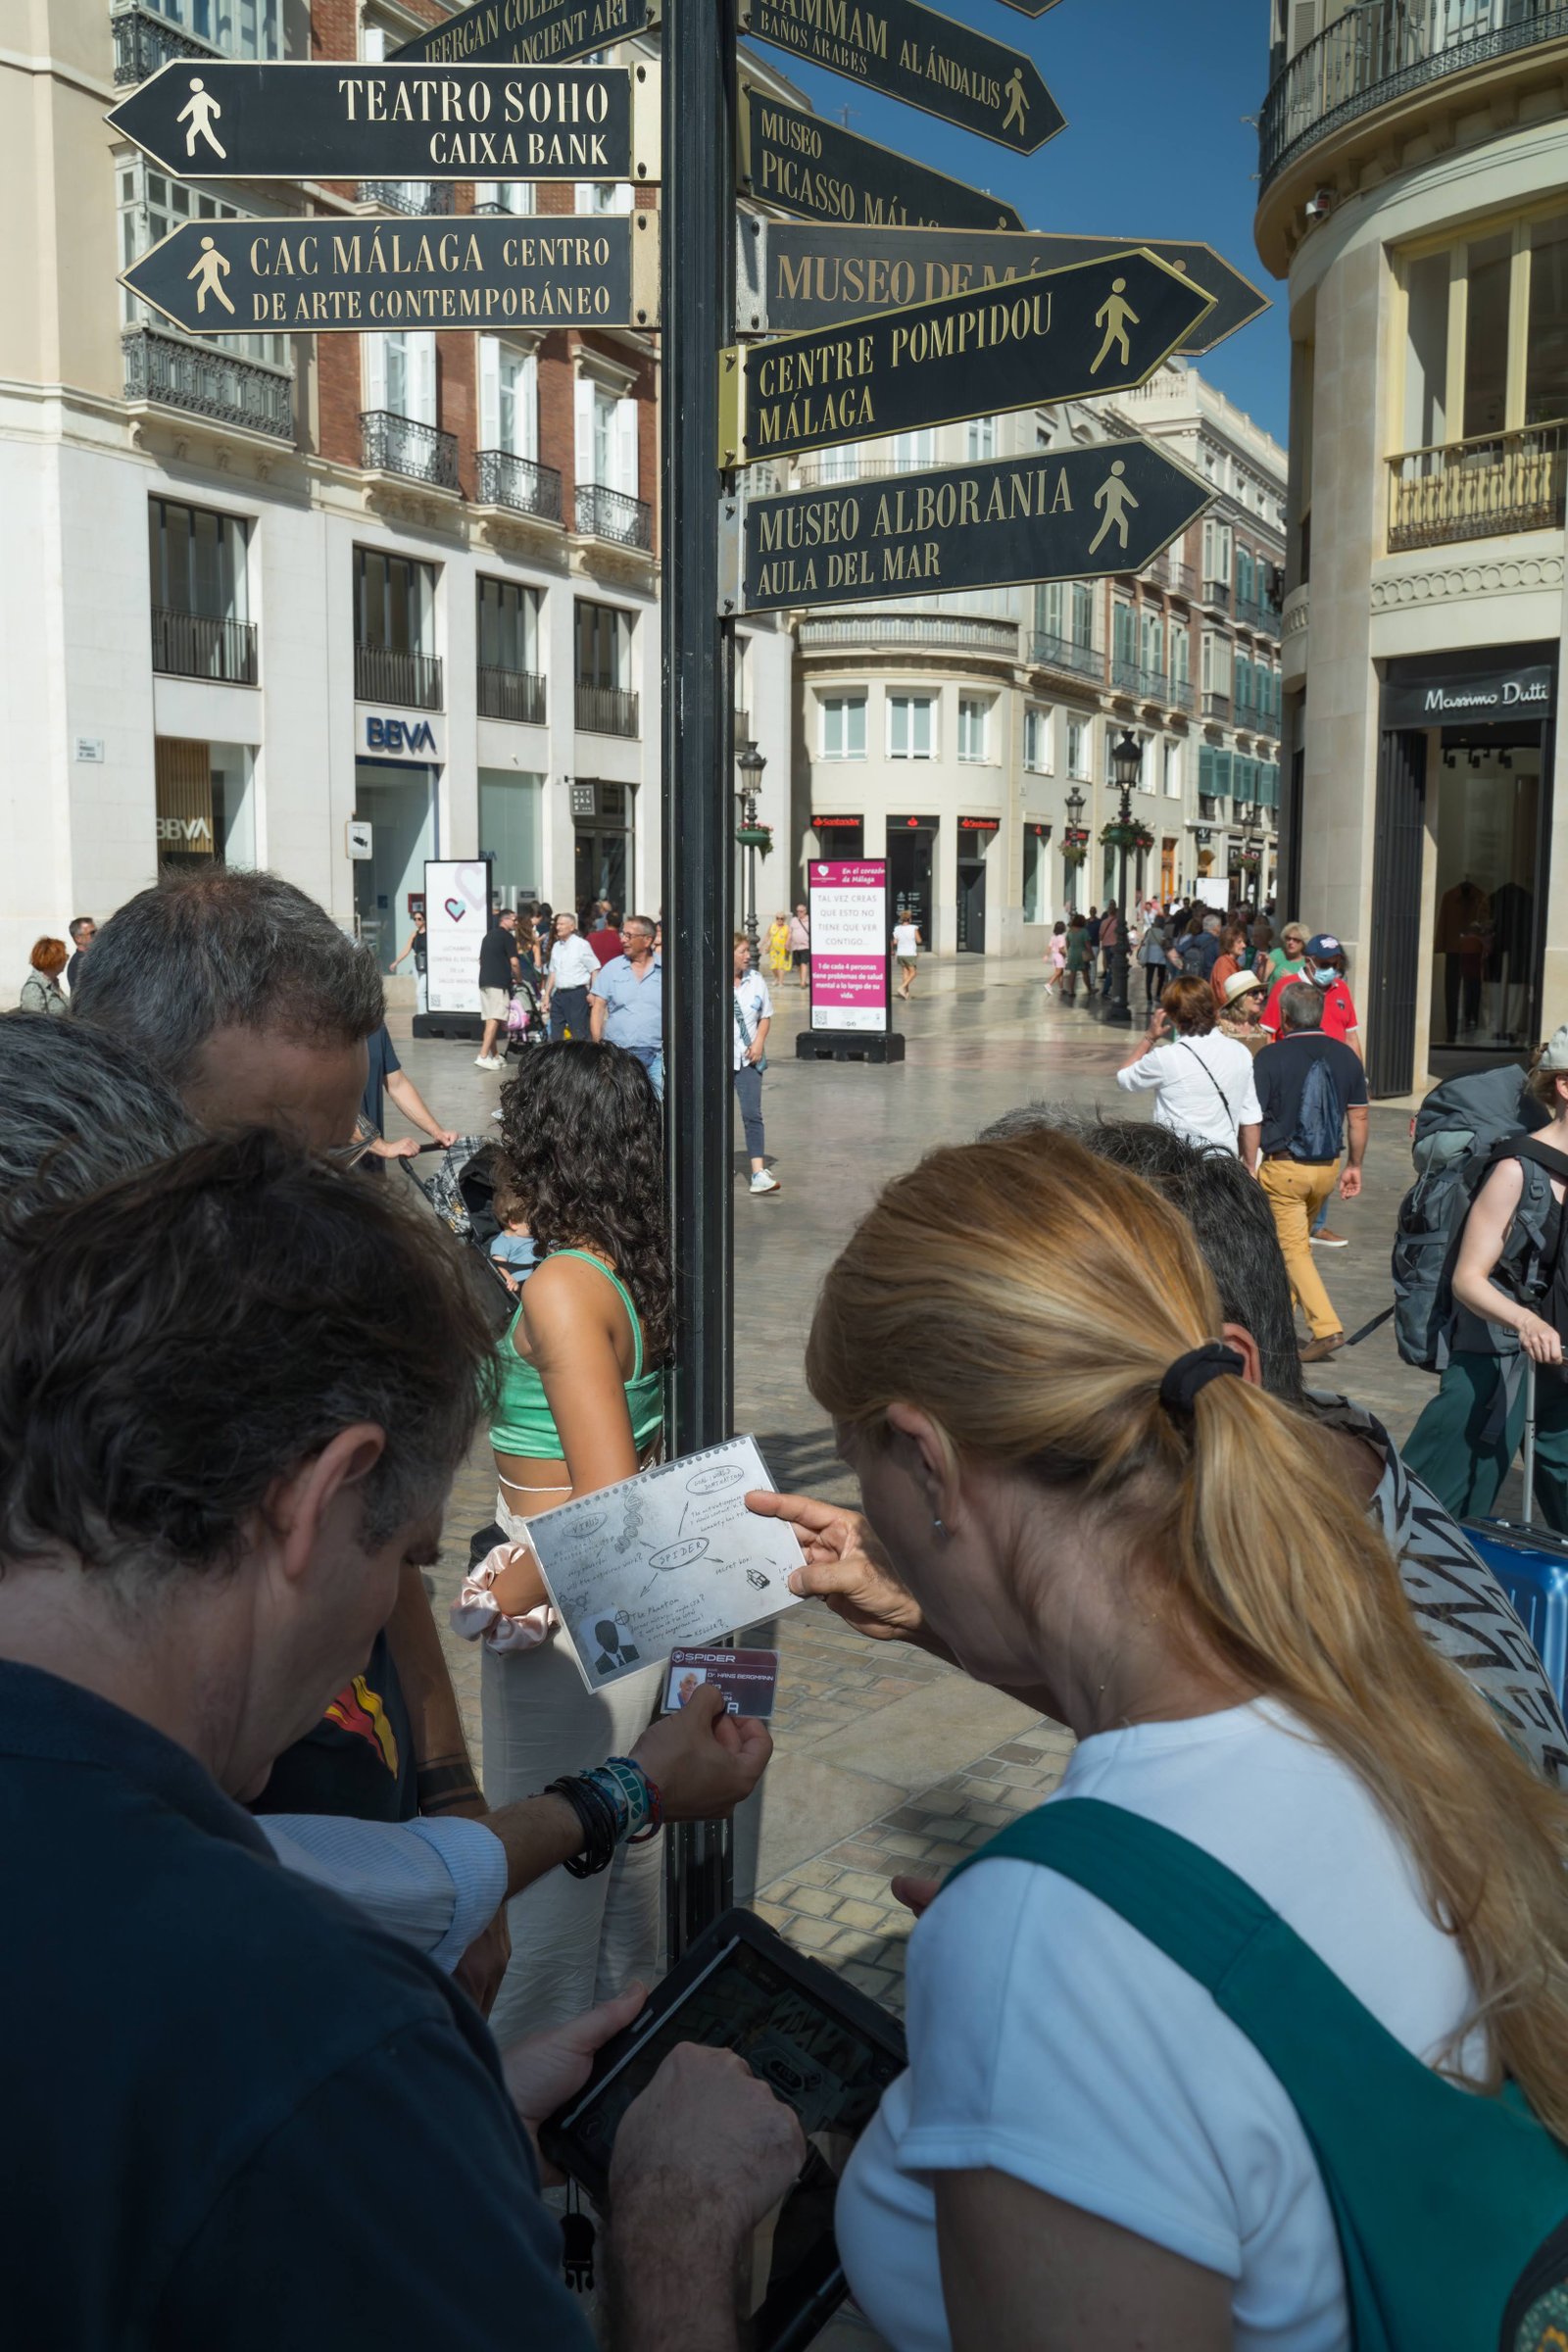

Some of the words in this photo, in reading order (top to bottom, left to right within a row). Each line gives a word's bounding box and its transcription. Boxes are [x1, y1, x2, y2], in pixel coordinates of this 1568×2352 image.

[512, 9, 587, 63] ANCIENT
[591, 0, 627, 36] ART
[760, 10, 808, 49] BAÑOS
[811, 30, 868, 75] ÁRABES
[899, 39, 922, 74] AL
[925, 44, 1001, 110] ÁNDALUS
[339, 79, 492, 122] TEATRO
[504, 81, 610, 123] SOHO
[428, 133, 520, 165] CAIXA
[528, 133, 610, 166] BANK
[761, 108, 822, 160] MUSEO
[760, 149, 856, 221] PICASSO
[249, 235, 319, 277] CAC
[332, 225, 485, 275] MÁLAGA
[502, 236, 611, 269] CENTRO
[252, 292, 286, 321] DE
[294, 289, 363, 321] ARTE
[368, 280, 611, 319] CONTEMPORÁNEO
[775, 254, 915, 305] MUSEO
[923, 262, 973, 301] DE
[759, 333, 876, 399] CENTRE
[889, 292, 1054, 368] POMPIDOU
[757, 385, 876, 446] MÁLAGA
[758, 497, 860, 554] MUSEO
[871, 466, 1075, 538] ALBORANIA
[757, 557, 818, 597] AULA
[827, 552, 875, 588] DEL
[882, 542, 942, 582] MAR
[1425, 689, 1497, 710] Massimo
[1501, 682, 1548, 705] Dutti
[366, 717, 437, 755] BBVA
[156, 816, 211, 841] BBVA
[823, 817, 860, 826] Santander
[659, 1541, 703, 1565] SPIDER
[685, 1653, 736, 1663] SPIDER
[726, 1702, 739, 1714] A
